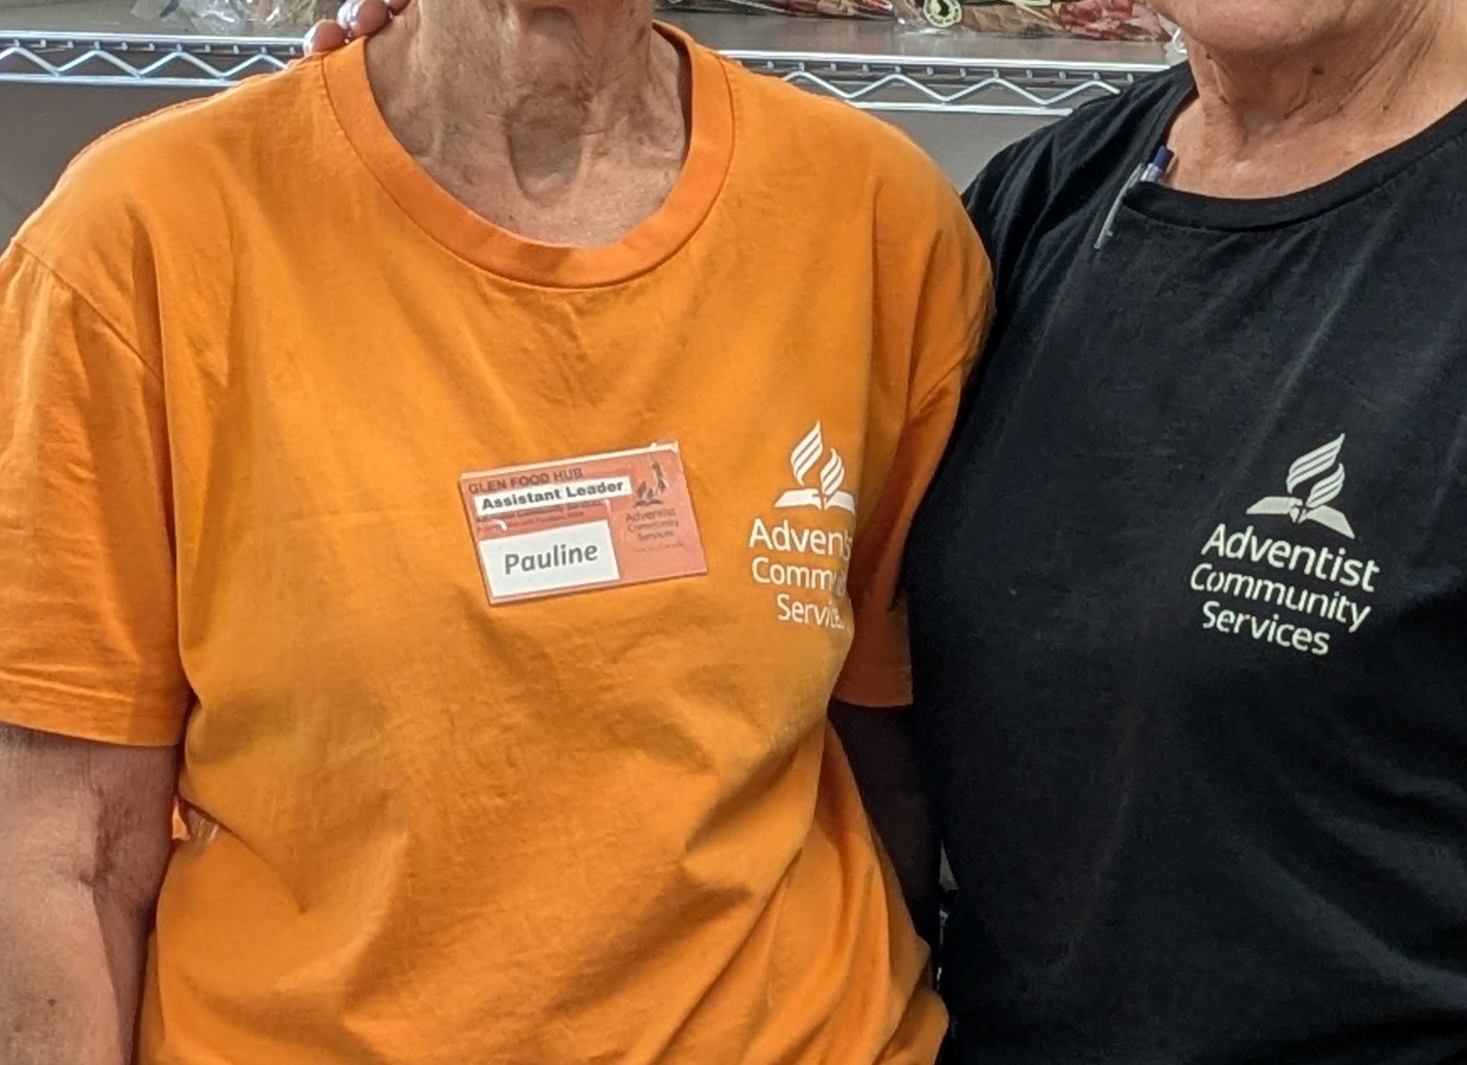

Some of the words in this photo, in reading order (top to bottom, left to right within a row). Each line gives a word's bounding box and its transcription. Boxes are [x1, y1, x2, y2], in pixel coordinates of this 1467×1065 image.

[468, 479, 507, 495] GLEN
[510, 473, 550, 489] FOOD
[553, 468, 584, 483] HUB
[481, 487, 561, 511] Assistant
[566, 479, 624, 498] Leader
[504, 539, 598, 575] Pauline
[1201, 523, 1381, 593] Adventist
[1189, 563, 1372, 634] Community
[1202, 600, 1331, 656] Services
